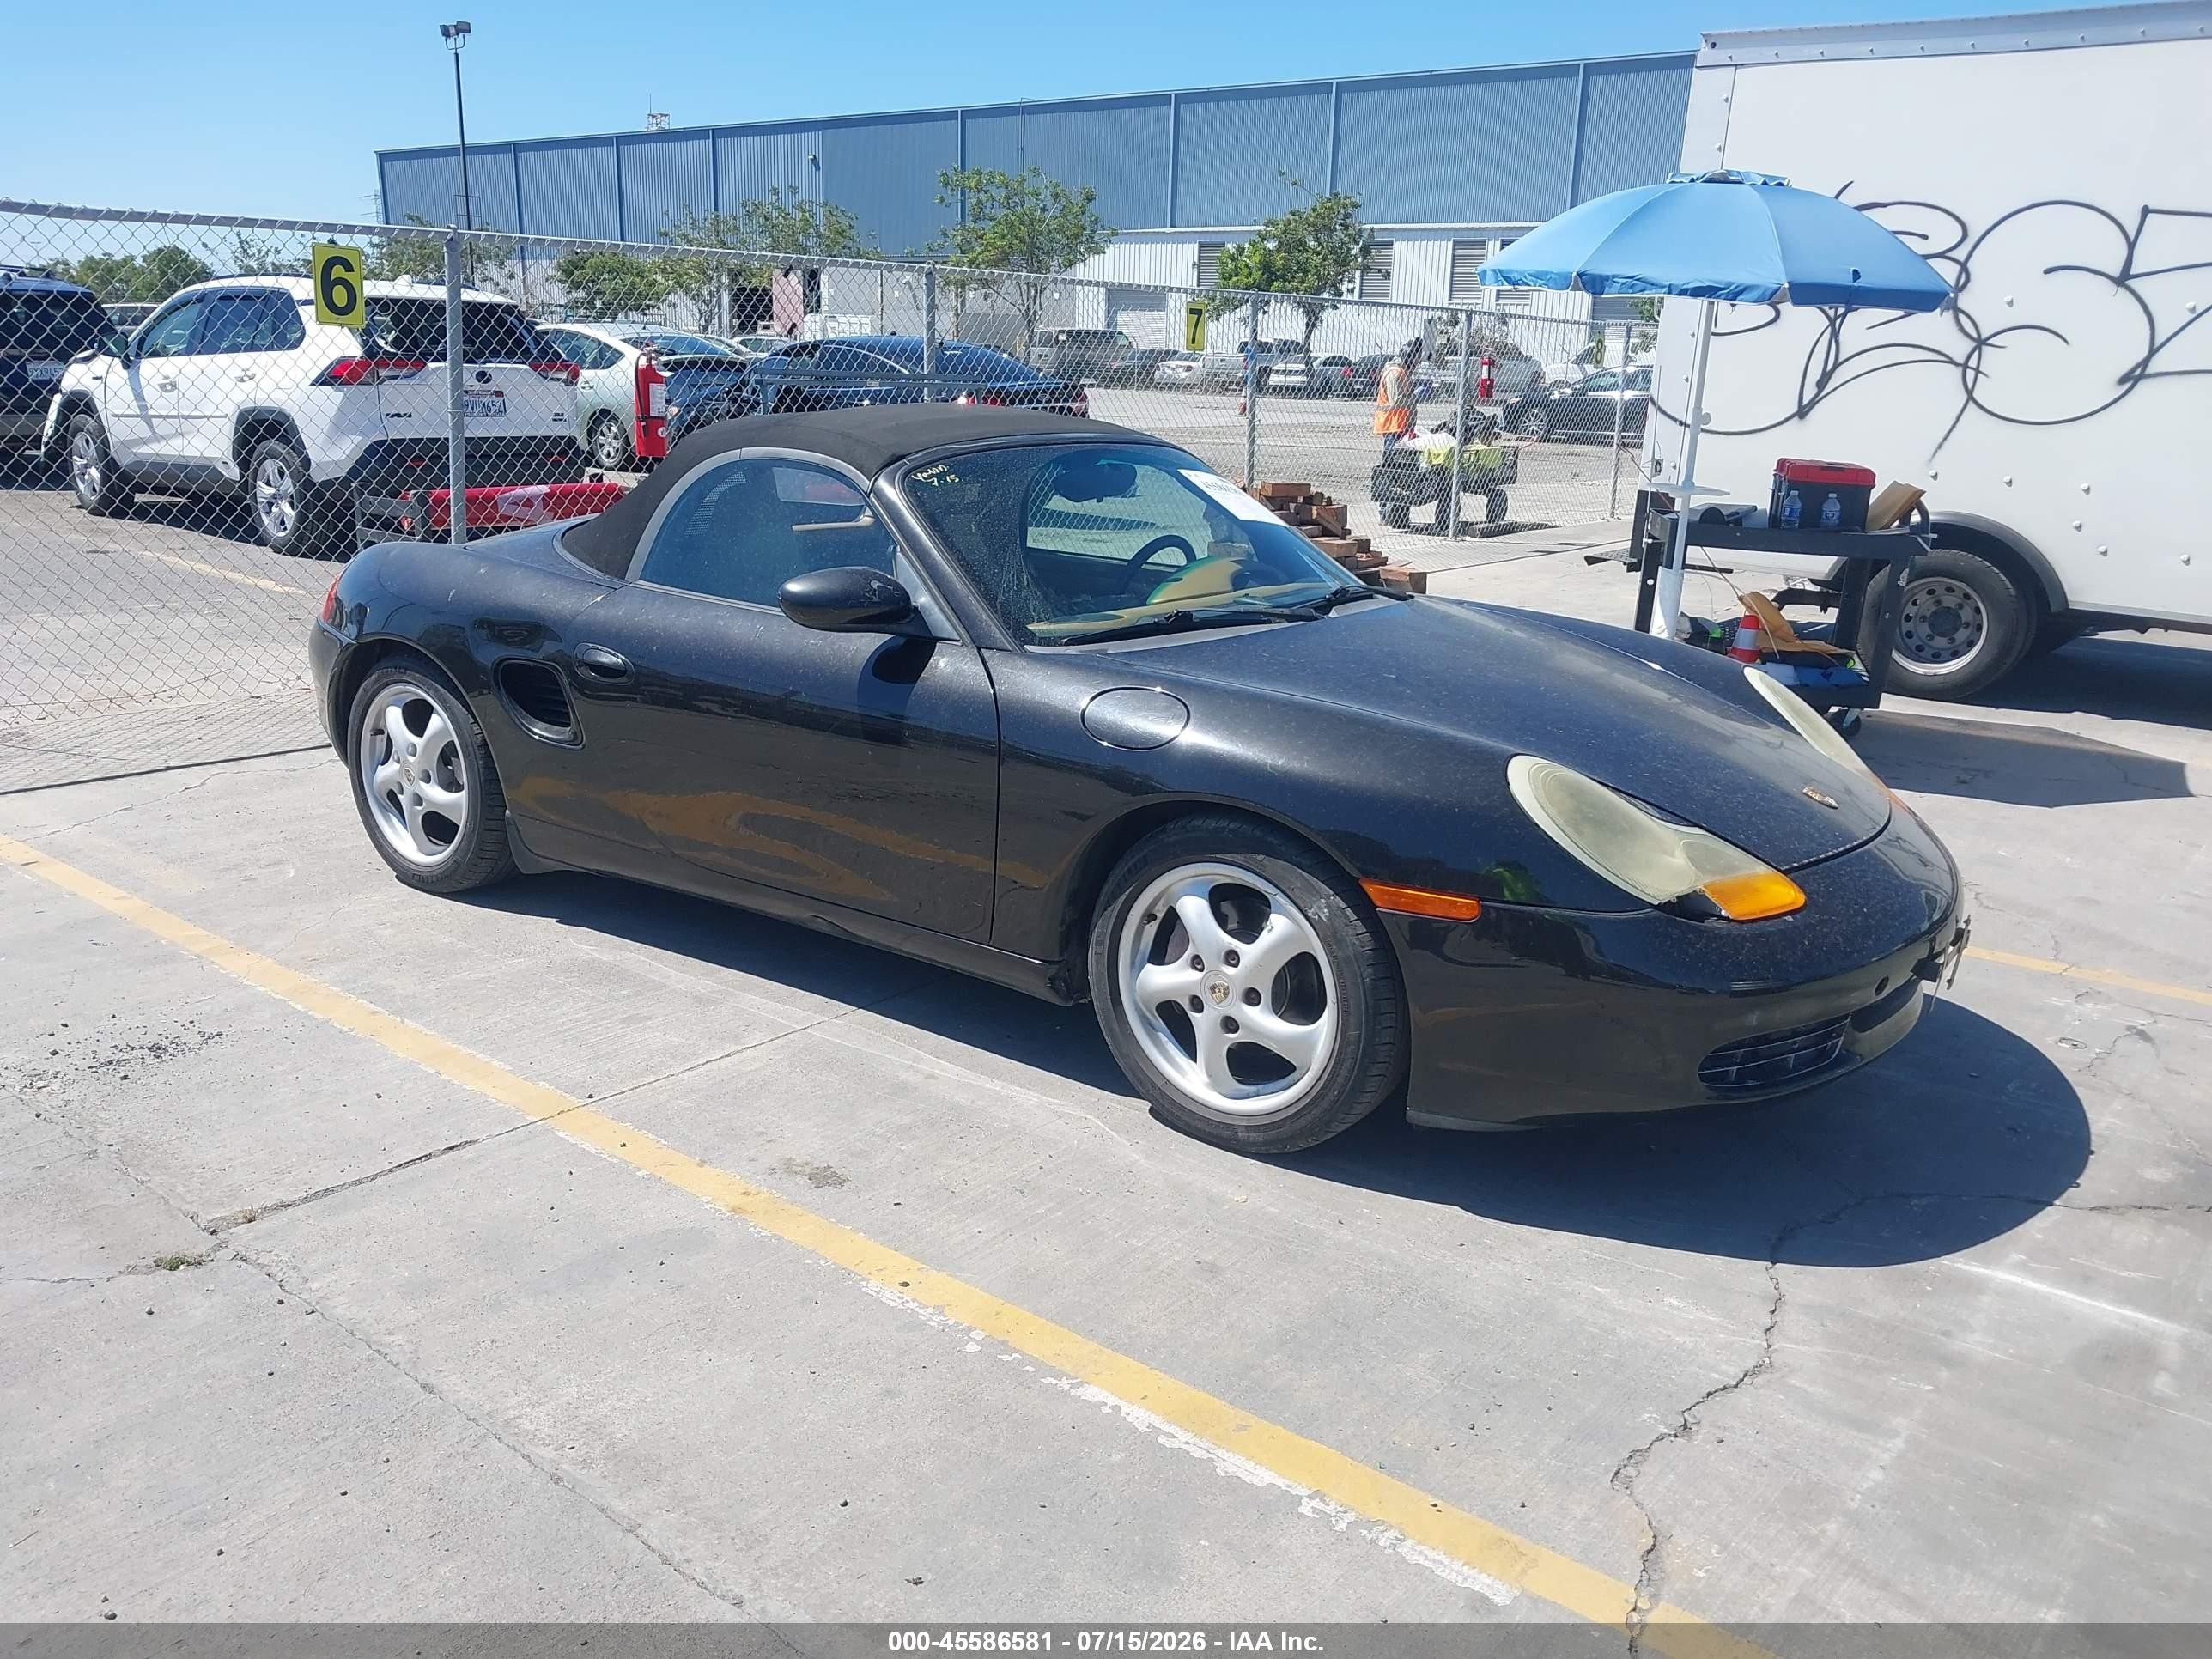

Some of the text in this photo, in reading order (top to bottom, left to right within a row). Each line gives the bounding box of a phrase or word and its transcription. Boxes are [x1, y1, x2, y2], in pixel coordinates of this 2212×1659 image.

[320, 255, 357, 317] 6
[1188, 307, 1203, 345] 7
[1595, 338, 1603, 365] 8
